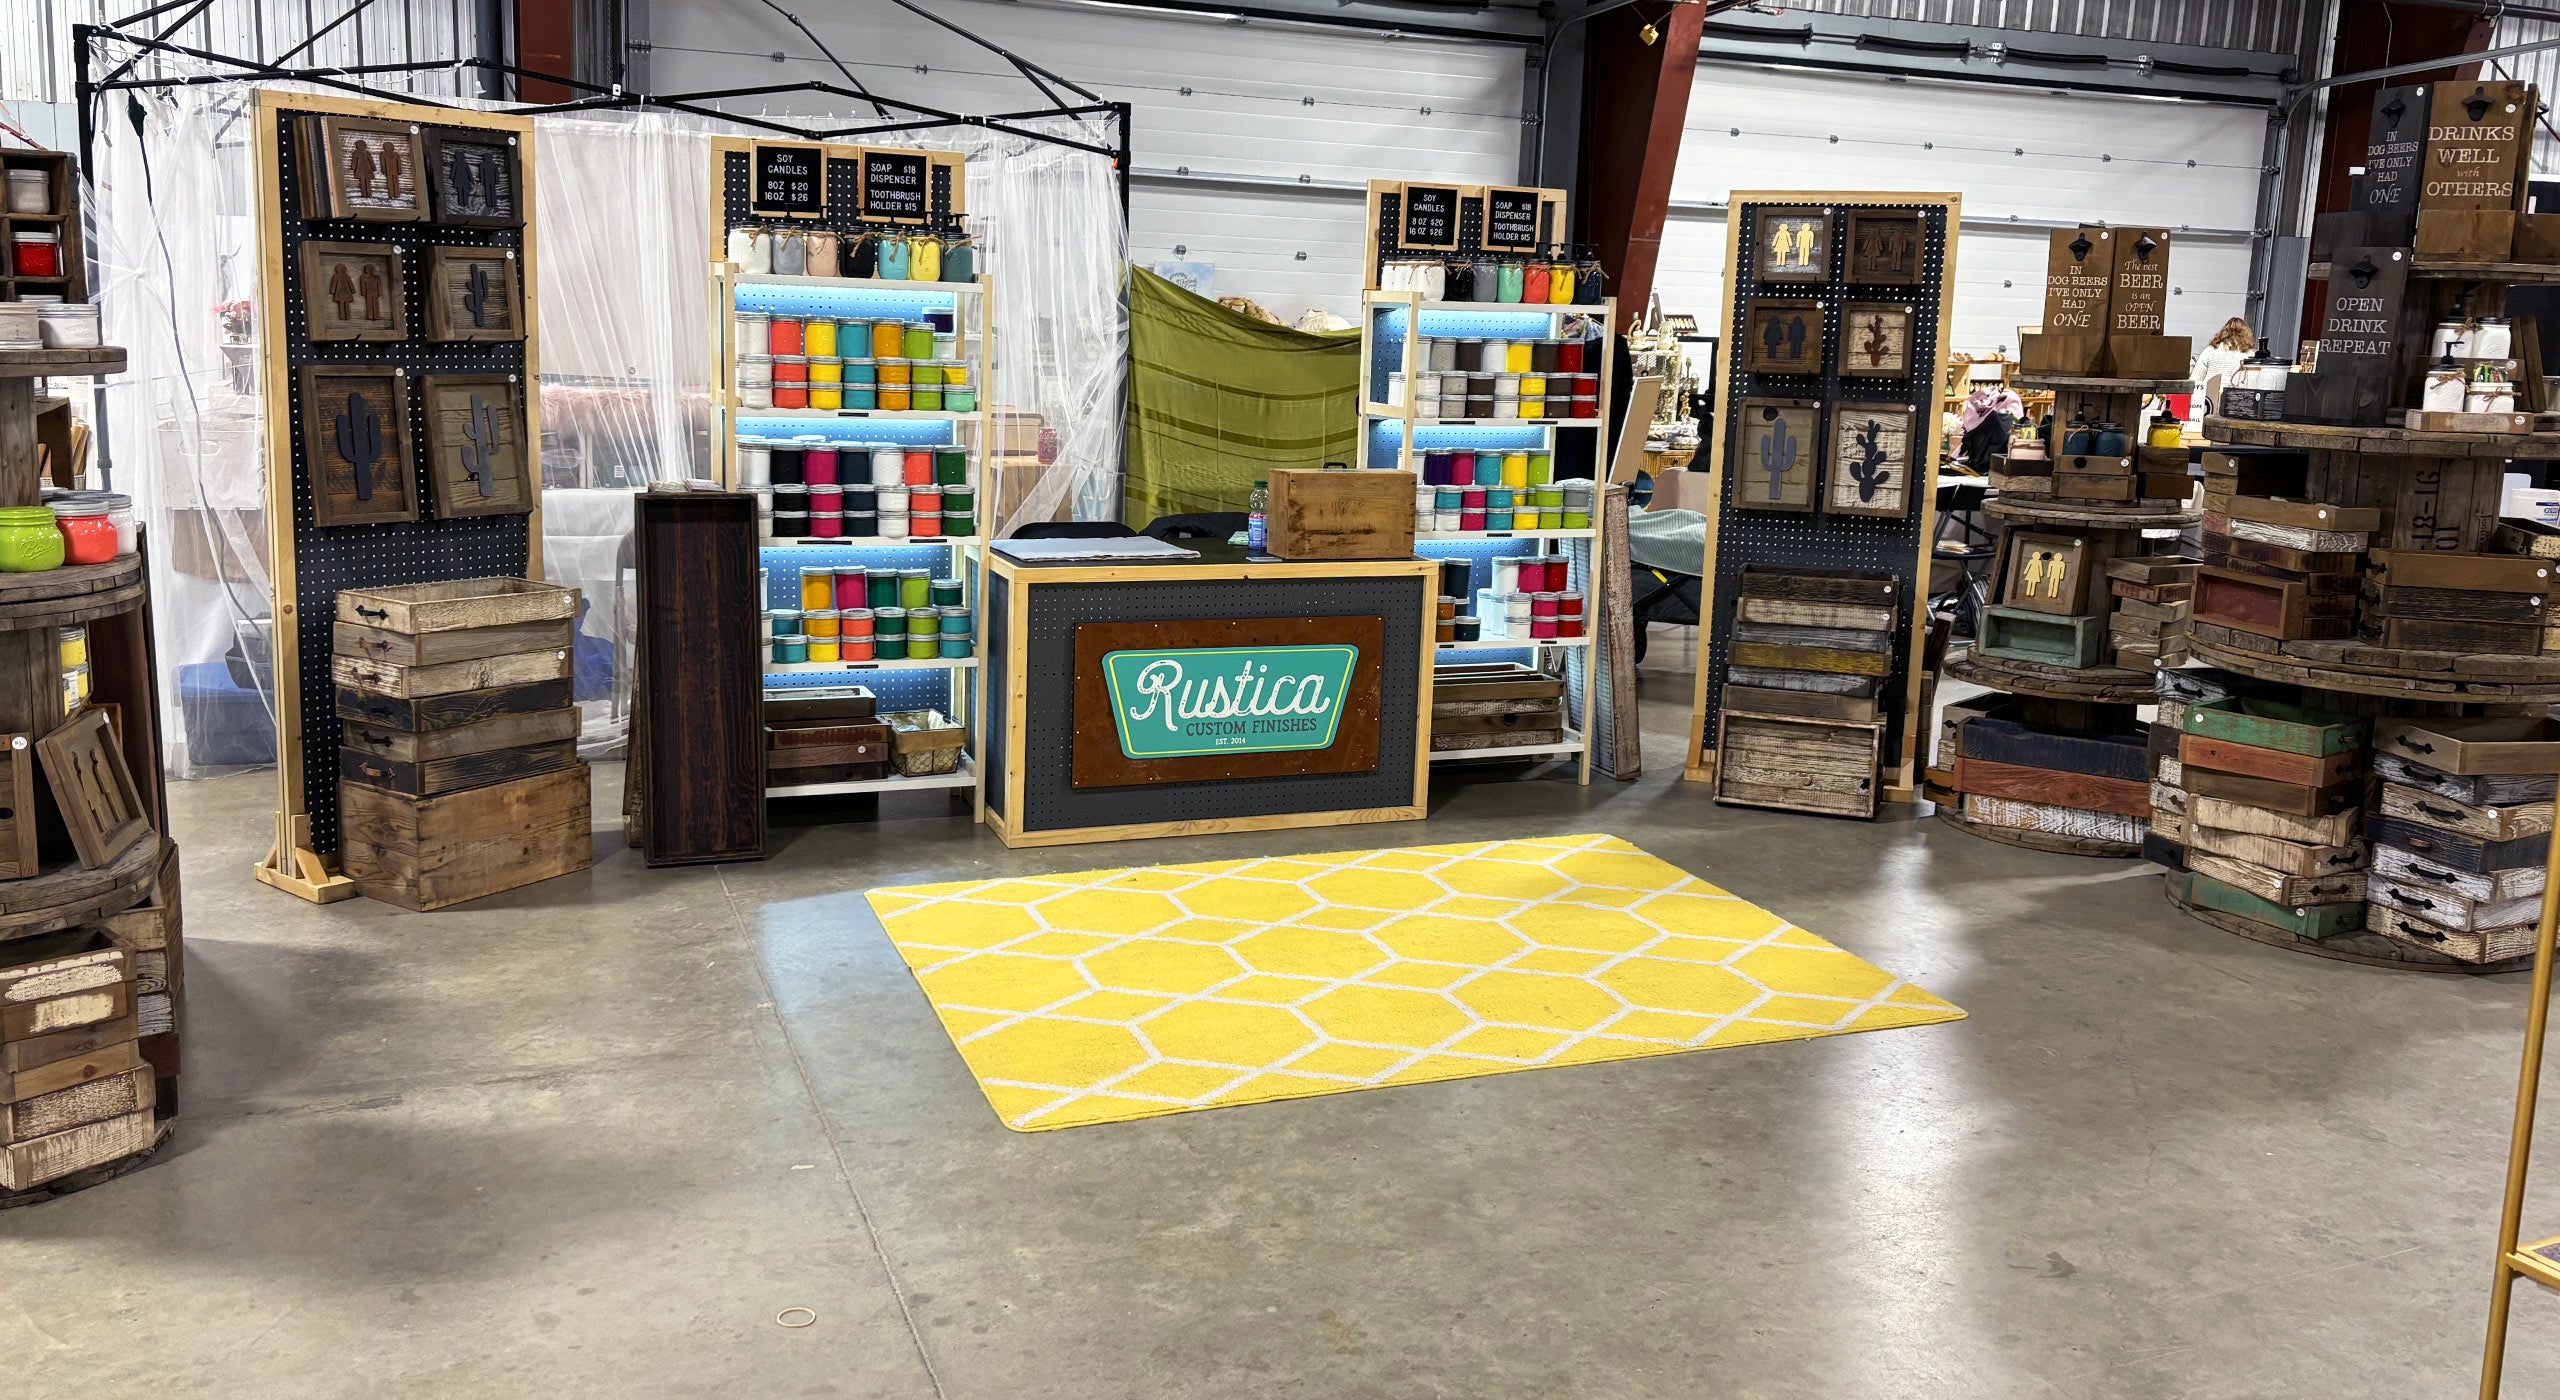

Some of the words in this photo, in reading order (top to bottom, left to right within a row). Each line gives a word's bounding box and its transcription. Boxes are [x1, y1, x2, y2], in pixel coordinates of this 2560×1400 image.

[2386, 132, 2396, 142] IN
[2428, 126, 2514, 141] DRINKS
[2368, 144, 2385, 156] DOG
[2387, 142, 2418, 154] BEERS
[776, 154, 793, 163] SOY
[2438, 148, 2500, 163] WELL
[2368, 159, 2386, 169] I'VE
[2387, 156, 2413, 168] ONLY
[767, 165, 808, 175] CANDLES
[870, 163, 892, 172] SOAP
[903, 166, 916, 174] $18
[2457, 168, 2480, 177] with
[870, 174, 917, 185] DISPENSER
[2377, 171, 2398, 182] HAD
[791, 182, 809, 191] $20
[2426, 182, 2513, 196] OTHERS
[791, 193, 809, 201] $26
[870, 190, 921, 201] TOOTHBRUSH
[1423, 194, 1437, 202] SOY
[2370, 184, 2401, 204] ONE
[870, 201, 901, 211] HOLDER
[905, 202, 917, 211] $15
[1414, 203, 1445, 212] CANDLES
[1495, 202, 1512, 210] SOAP
[1522, 203, 1532, 211] $18
[1495, 211, 1531, 220] DISPENSER
[1430, 228, 1443, 236] $26
[1494, 223, 1534, 232] TOOTHBRUSH
[1493, 232, 1519, 241] HOLDER
[2070, 266, 2082, 274] IN
[2124, 259, 2140, 271] The
[2143, 260, 2159, 271] best
[2048, 276, 2069, 284] DOG
[2072, 277, 2108, 285] BEERS
[2120, 274, 2163, 289] BEER
[2048, 288, 2069, 297] I'VE
[2072, 288, 2102, 298] ONLY
[2132, 292, 2138, 300] is
[2062, 300, 2086, 308] HAD
[2125, 301, 2156, 312] OPEN
[2336, 298, 2384, 312] OPEN
[2054, 311, 2091, 327] ONE
[2117, 315, 2160, 329] BEER
[2328, 320, 2387, 334] DRINK
[2320, 339, 2390, 354] REPEAT
[1130, 659, 1330, 731] Rustica
[1186, 721, 1246, 736] CUSTOM
[1252, 718, 1317, 734] FINISHES
[1231, 737, 1246, 745] 2014
